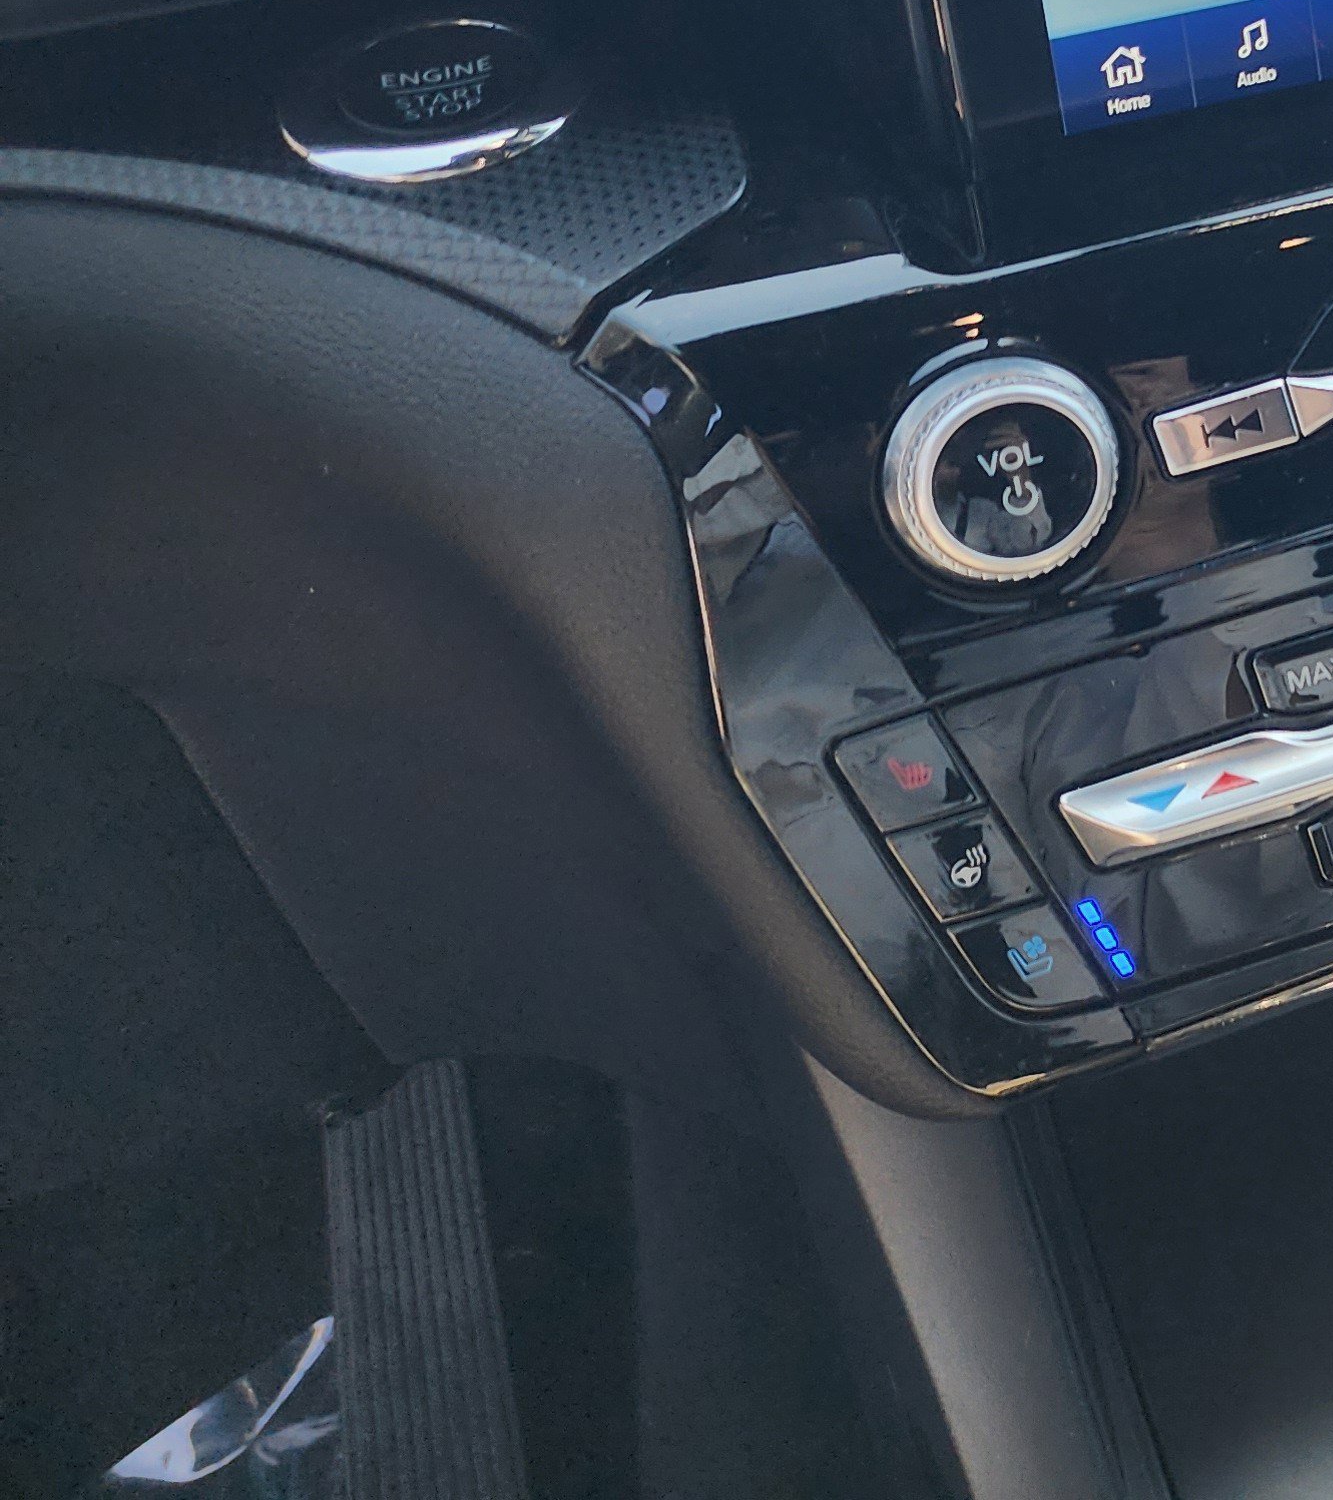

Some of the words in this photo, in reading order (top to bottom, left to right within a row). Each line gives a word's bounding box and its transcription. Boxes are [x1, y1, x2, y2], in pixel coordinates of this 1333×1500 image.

[380, 54, 493, 90] ENGINE
[1236, 66, 1277, 88] Audio
[396, 83, 485, 111] START
[402, 98, 483, 122] STOP
[1106, 93, 1151, 116] Home
[976, 440, 1045, 478] VOL
